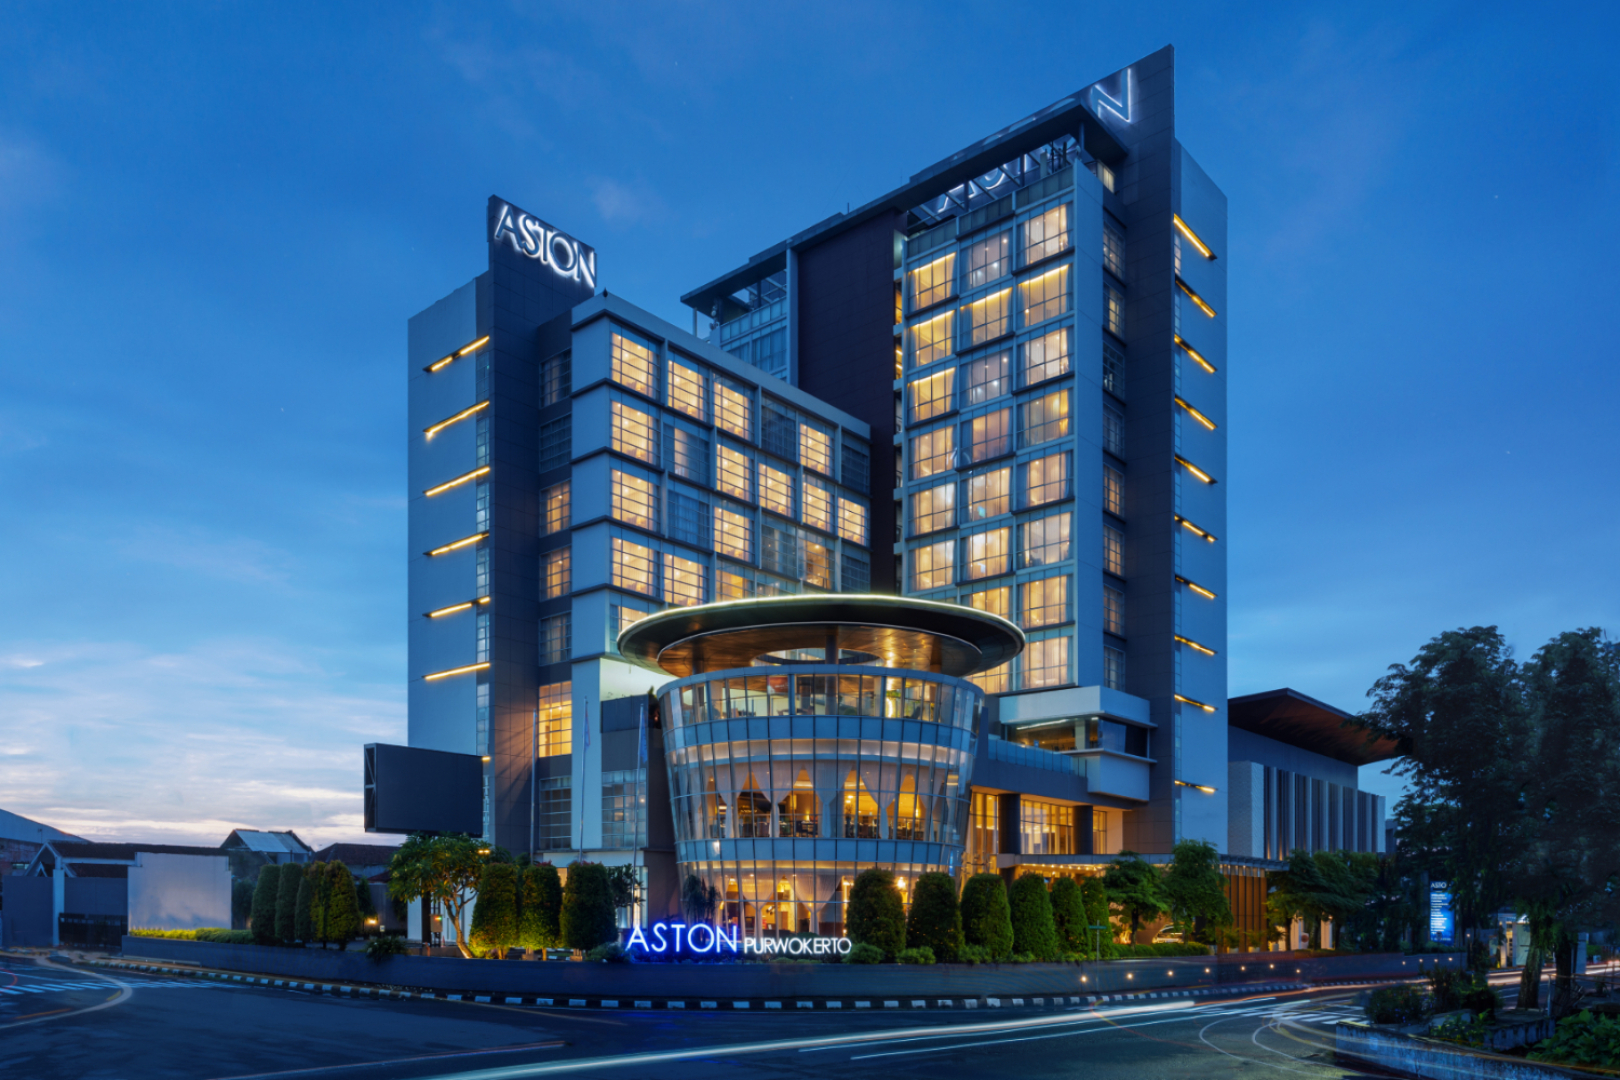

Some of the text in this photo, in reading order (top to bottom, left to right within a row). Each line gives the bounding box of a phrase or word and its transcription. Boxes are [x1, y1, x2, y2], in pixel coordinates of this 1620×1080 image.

[494, 204, 597, 288] ASTON
[625, 922, 852, 955] ASTON PURWOKERTO
